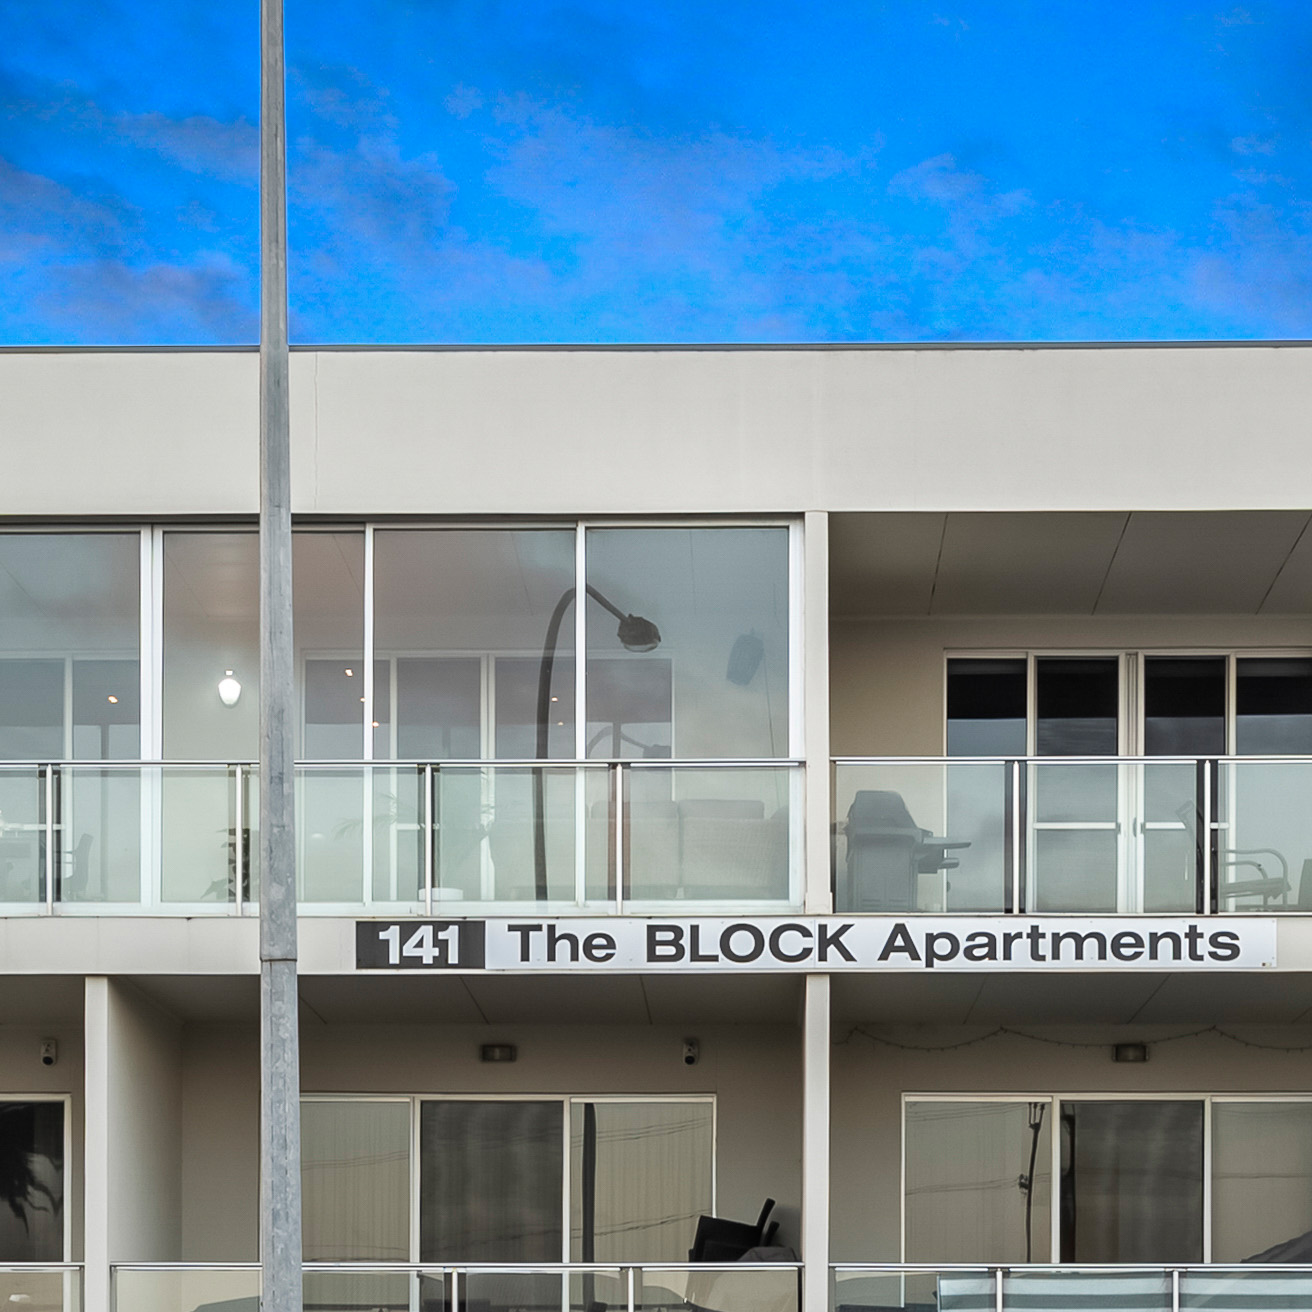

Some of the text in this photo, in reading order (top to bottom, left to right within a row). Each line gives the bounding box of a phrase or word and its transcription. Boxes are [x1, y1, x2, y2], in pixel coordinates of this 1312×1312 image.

[378, 922, 1241, 969] 141 The BLOCK Apartments
